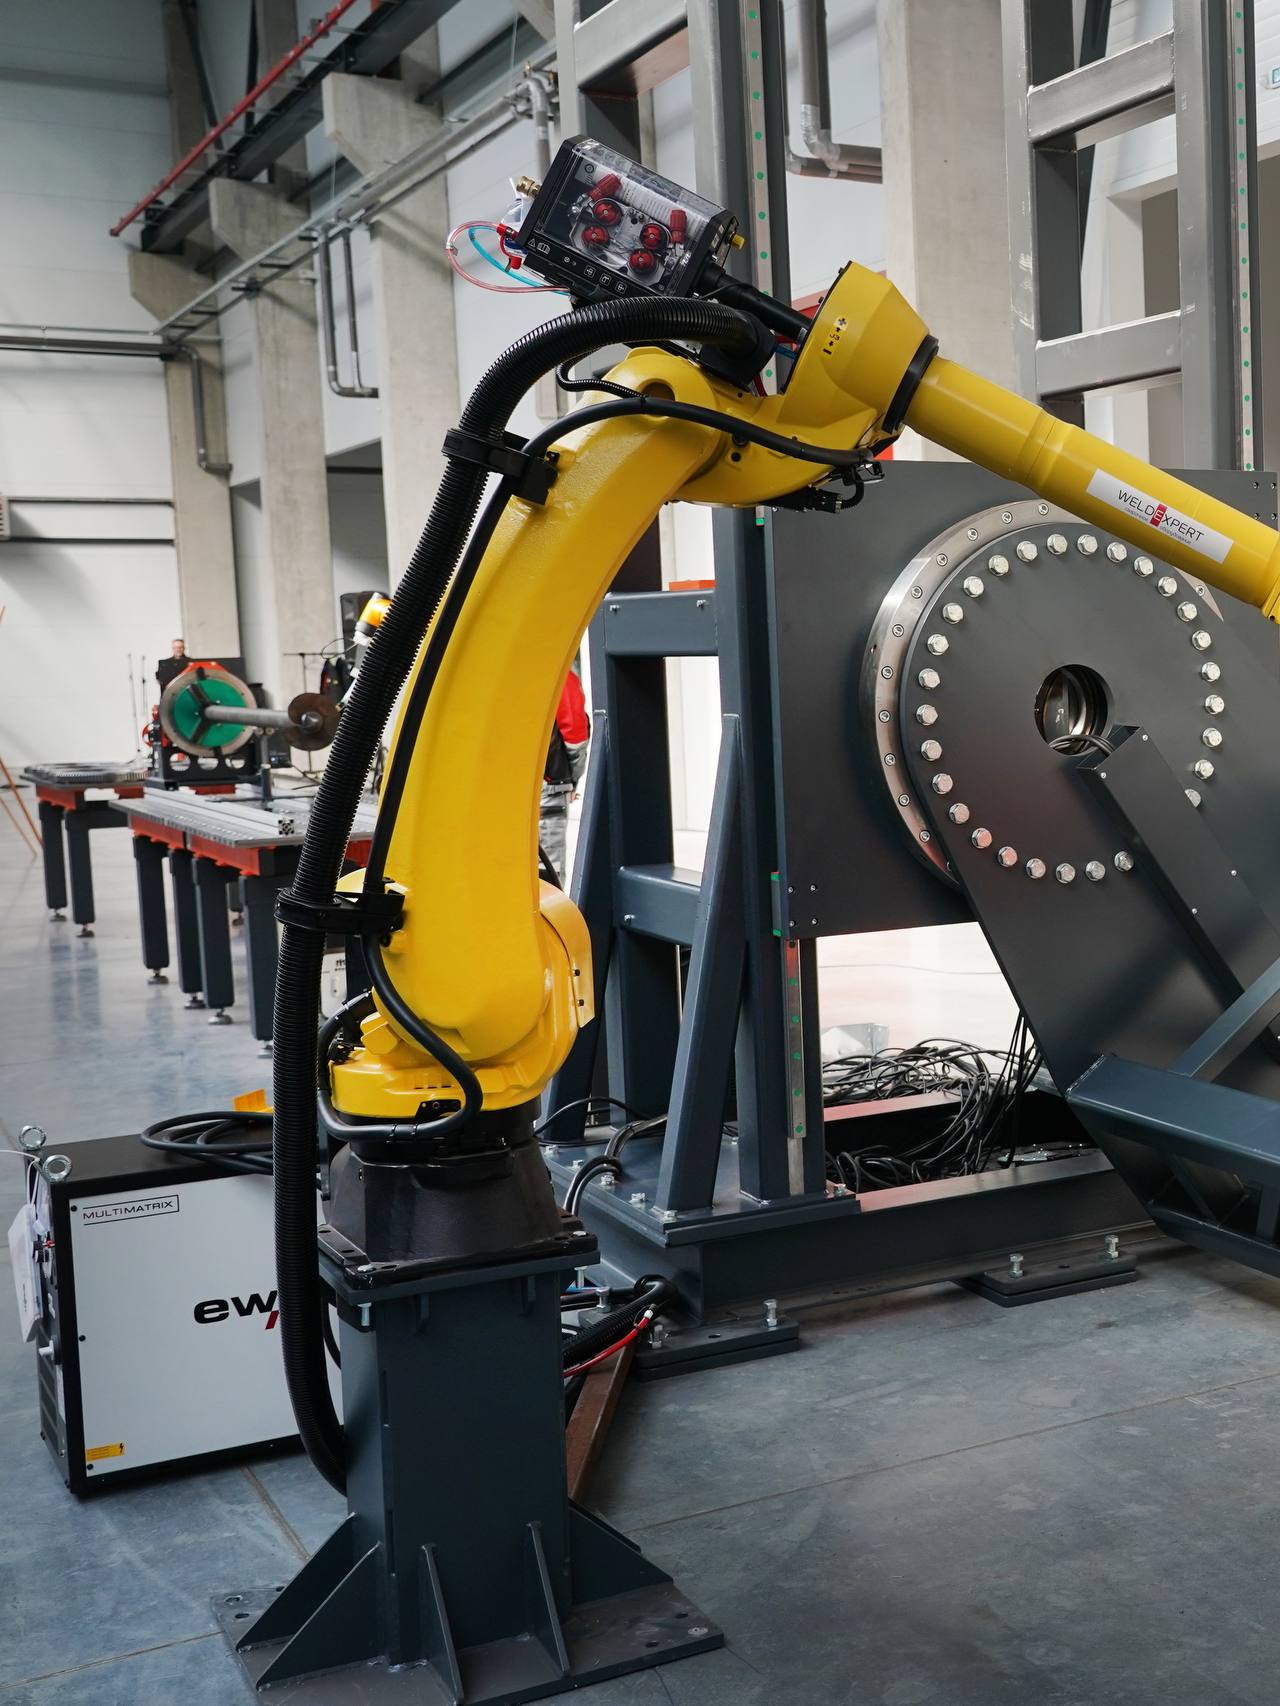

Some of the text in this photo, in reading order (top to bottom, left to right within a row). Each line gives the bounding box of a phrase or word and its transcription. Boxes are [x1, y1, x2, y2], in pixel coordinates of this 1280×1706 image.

[1118, 489, 1205, 541] WELDEXPERT
[83, 1200, 173, 1220] MULTIMATRIX
[193, 1290, 279, 1326] ew
